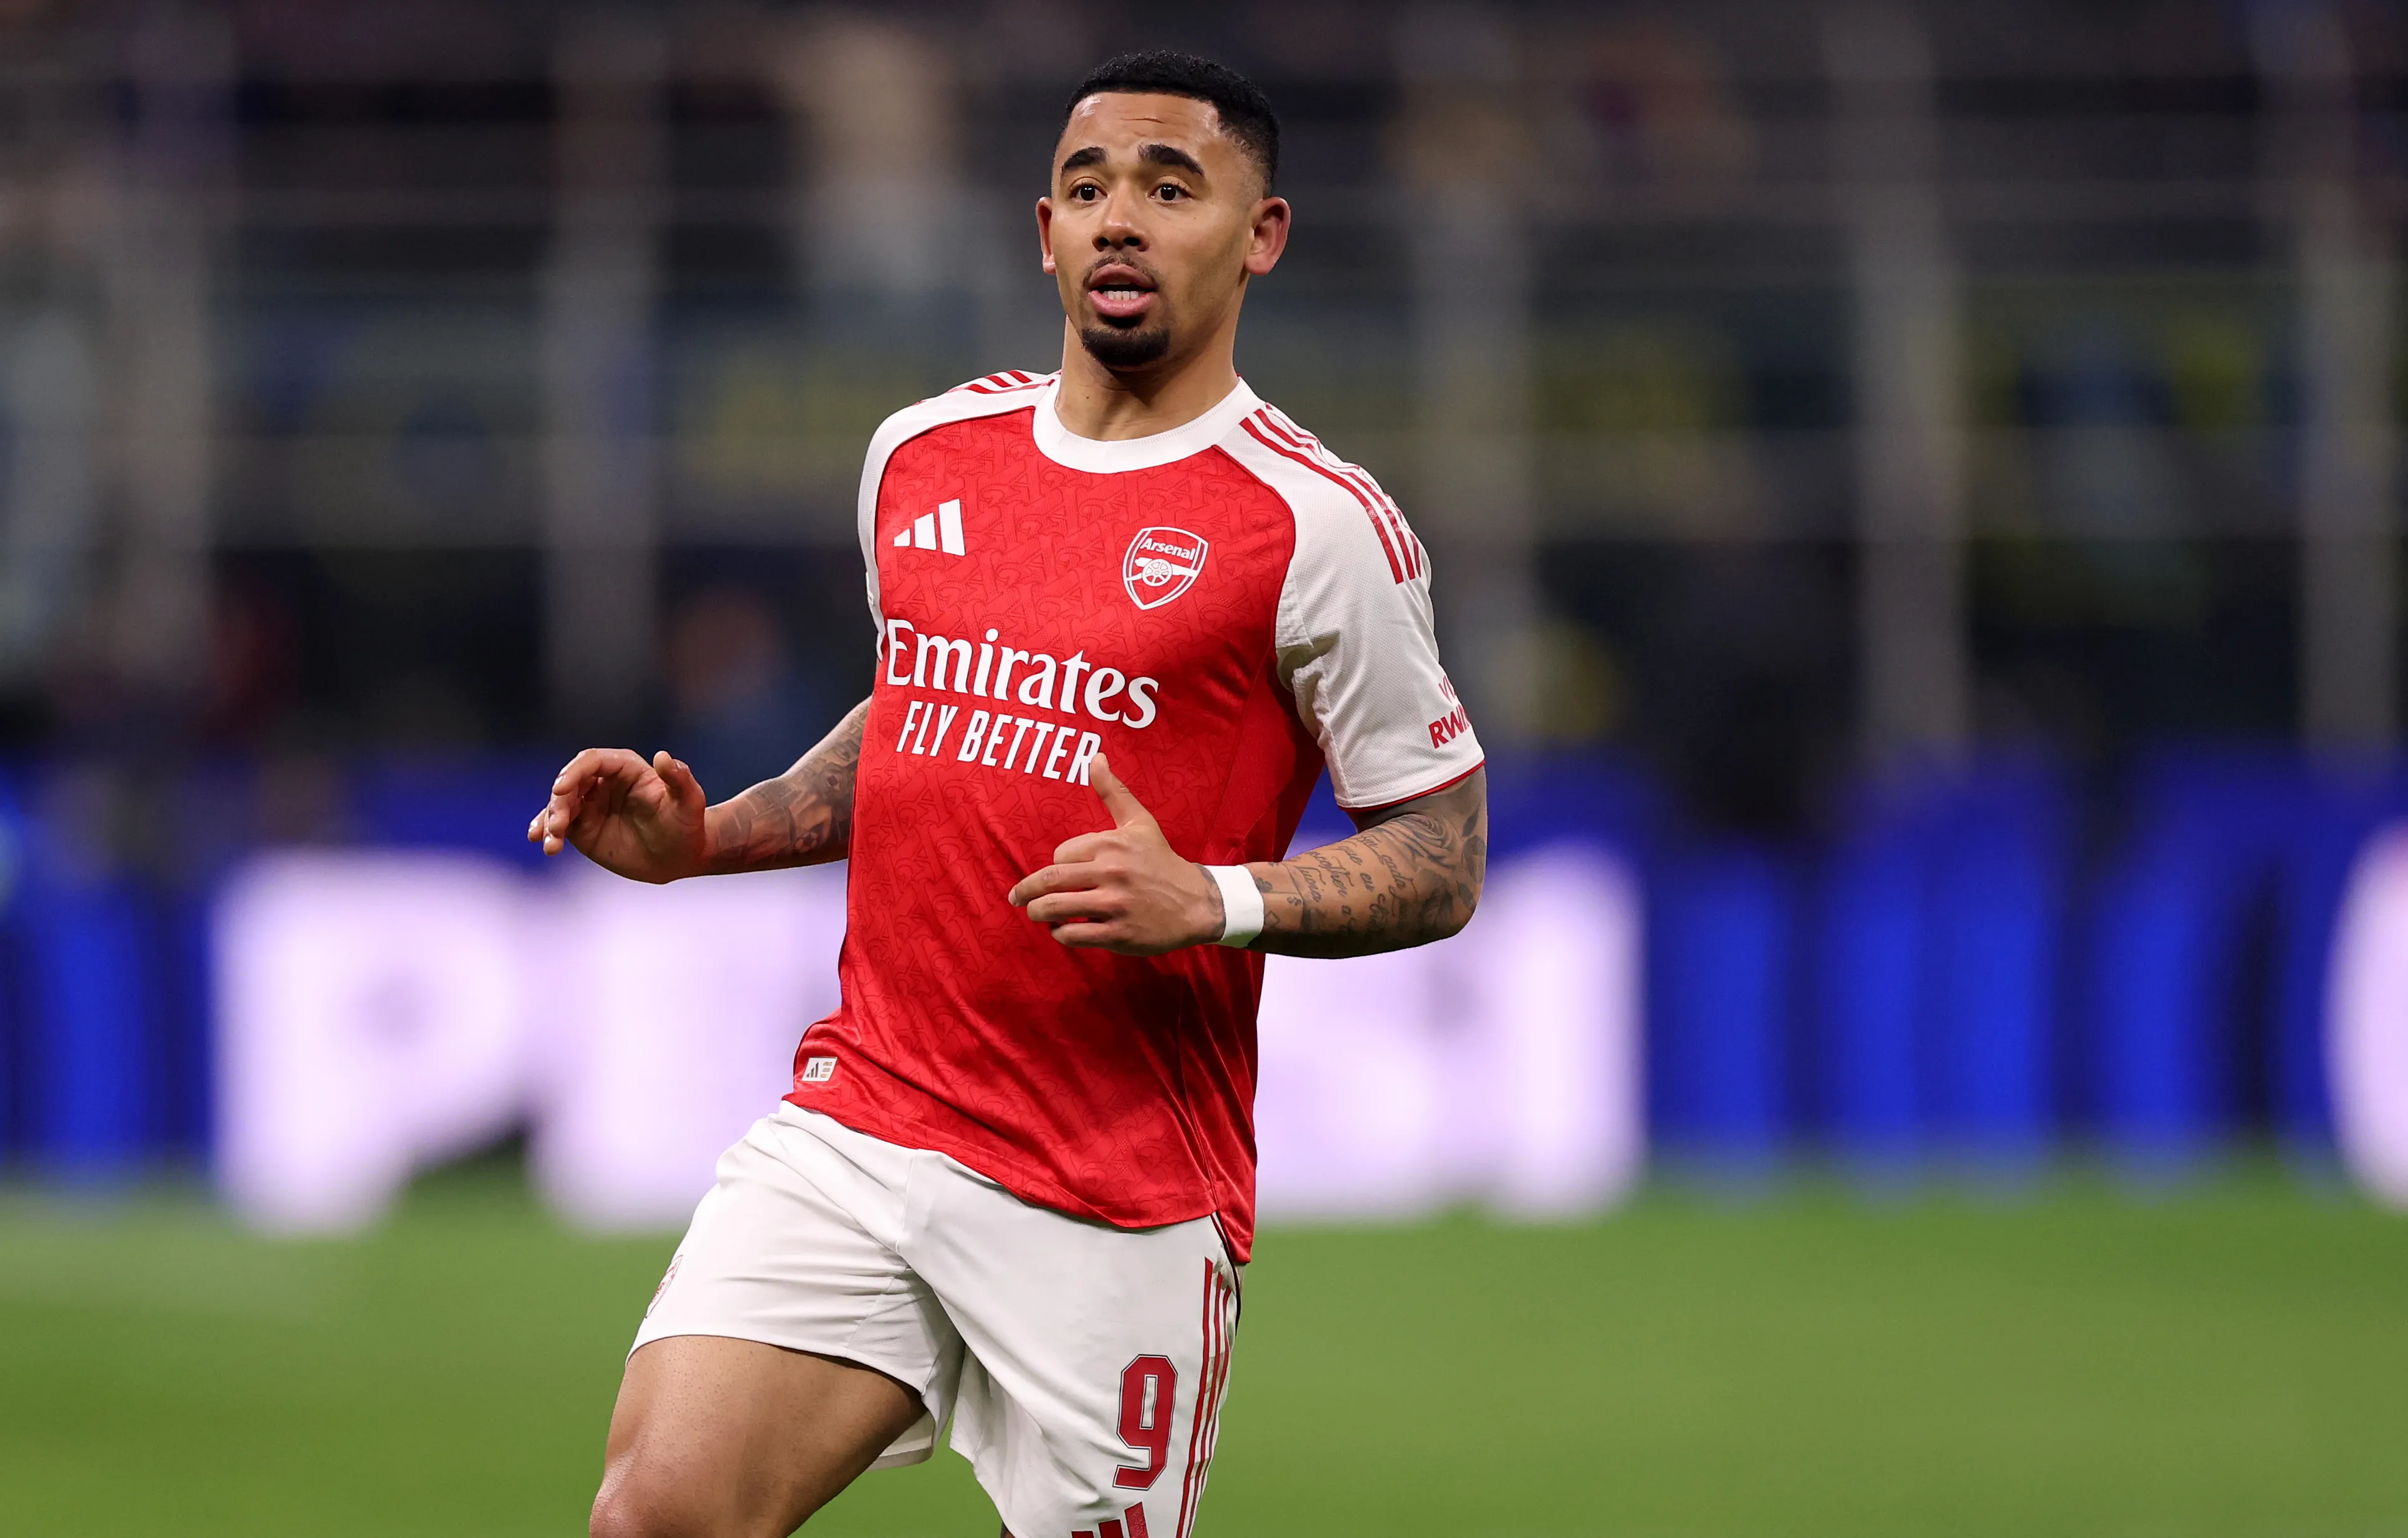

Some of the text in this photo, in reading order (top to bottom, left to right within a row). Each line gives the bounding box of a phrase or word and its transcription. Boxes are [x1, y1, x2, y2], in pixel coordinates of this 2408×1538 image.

[1140, 538, 1196, 560] Arsenal
[886, 618, 1159, 729] Emirates
[896, 700, 1102, 786] FLY BETTER
[1112, 1354, 1178, 1491] 9
